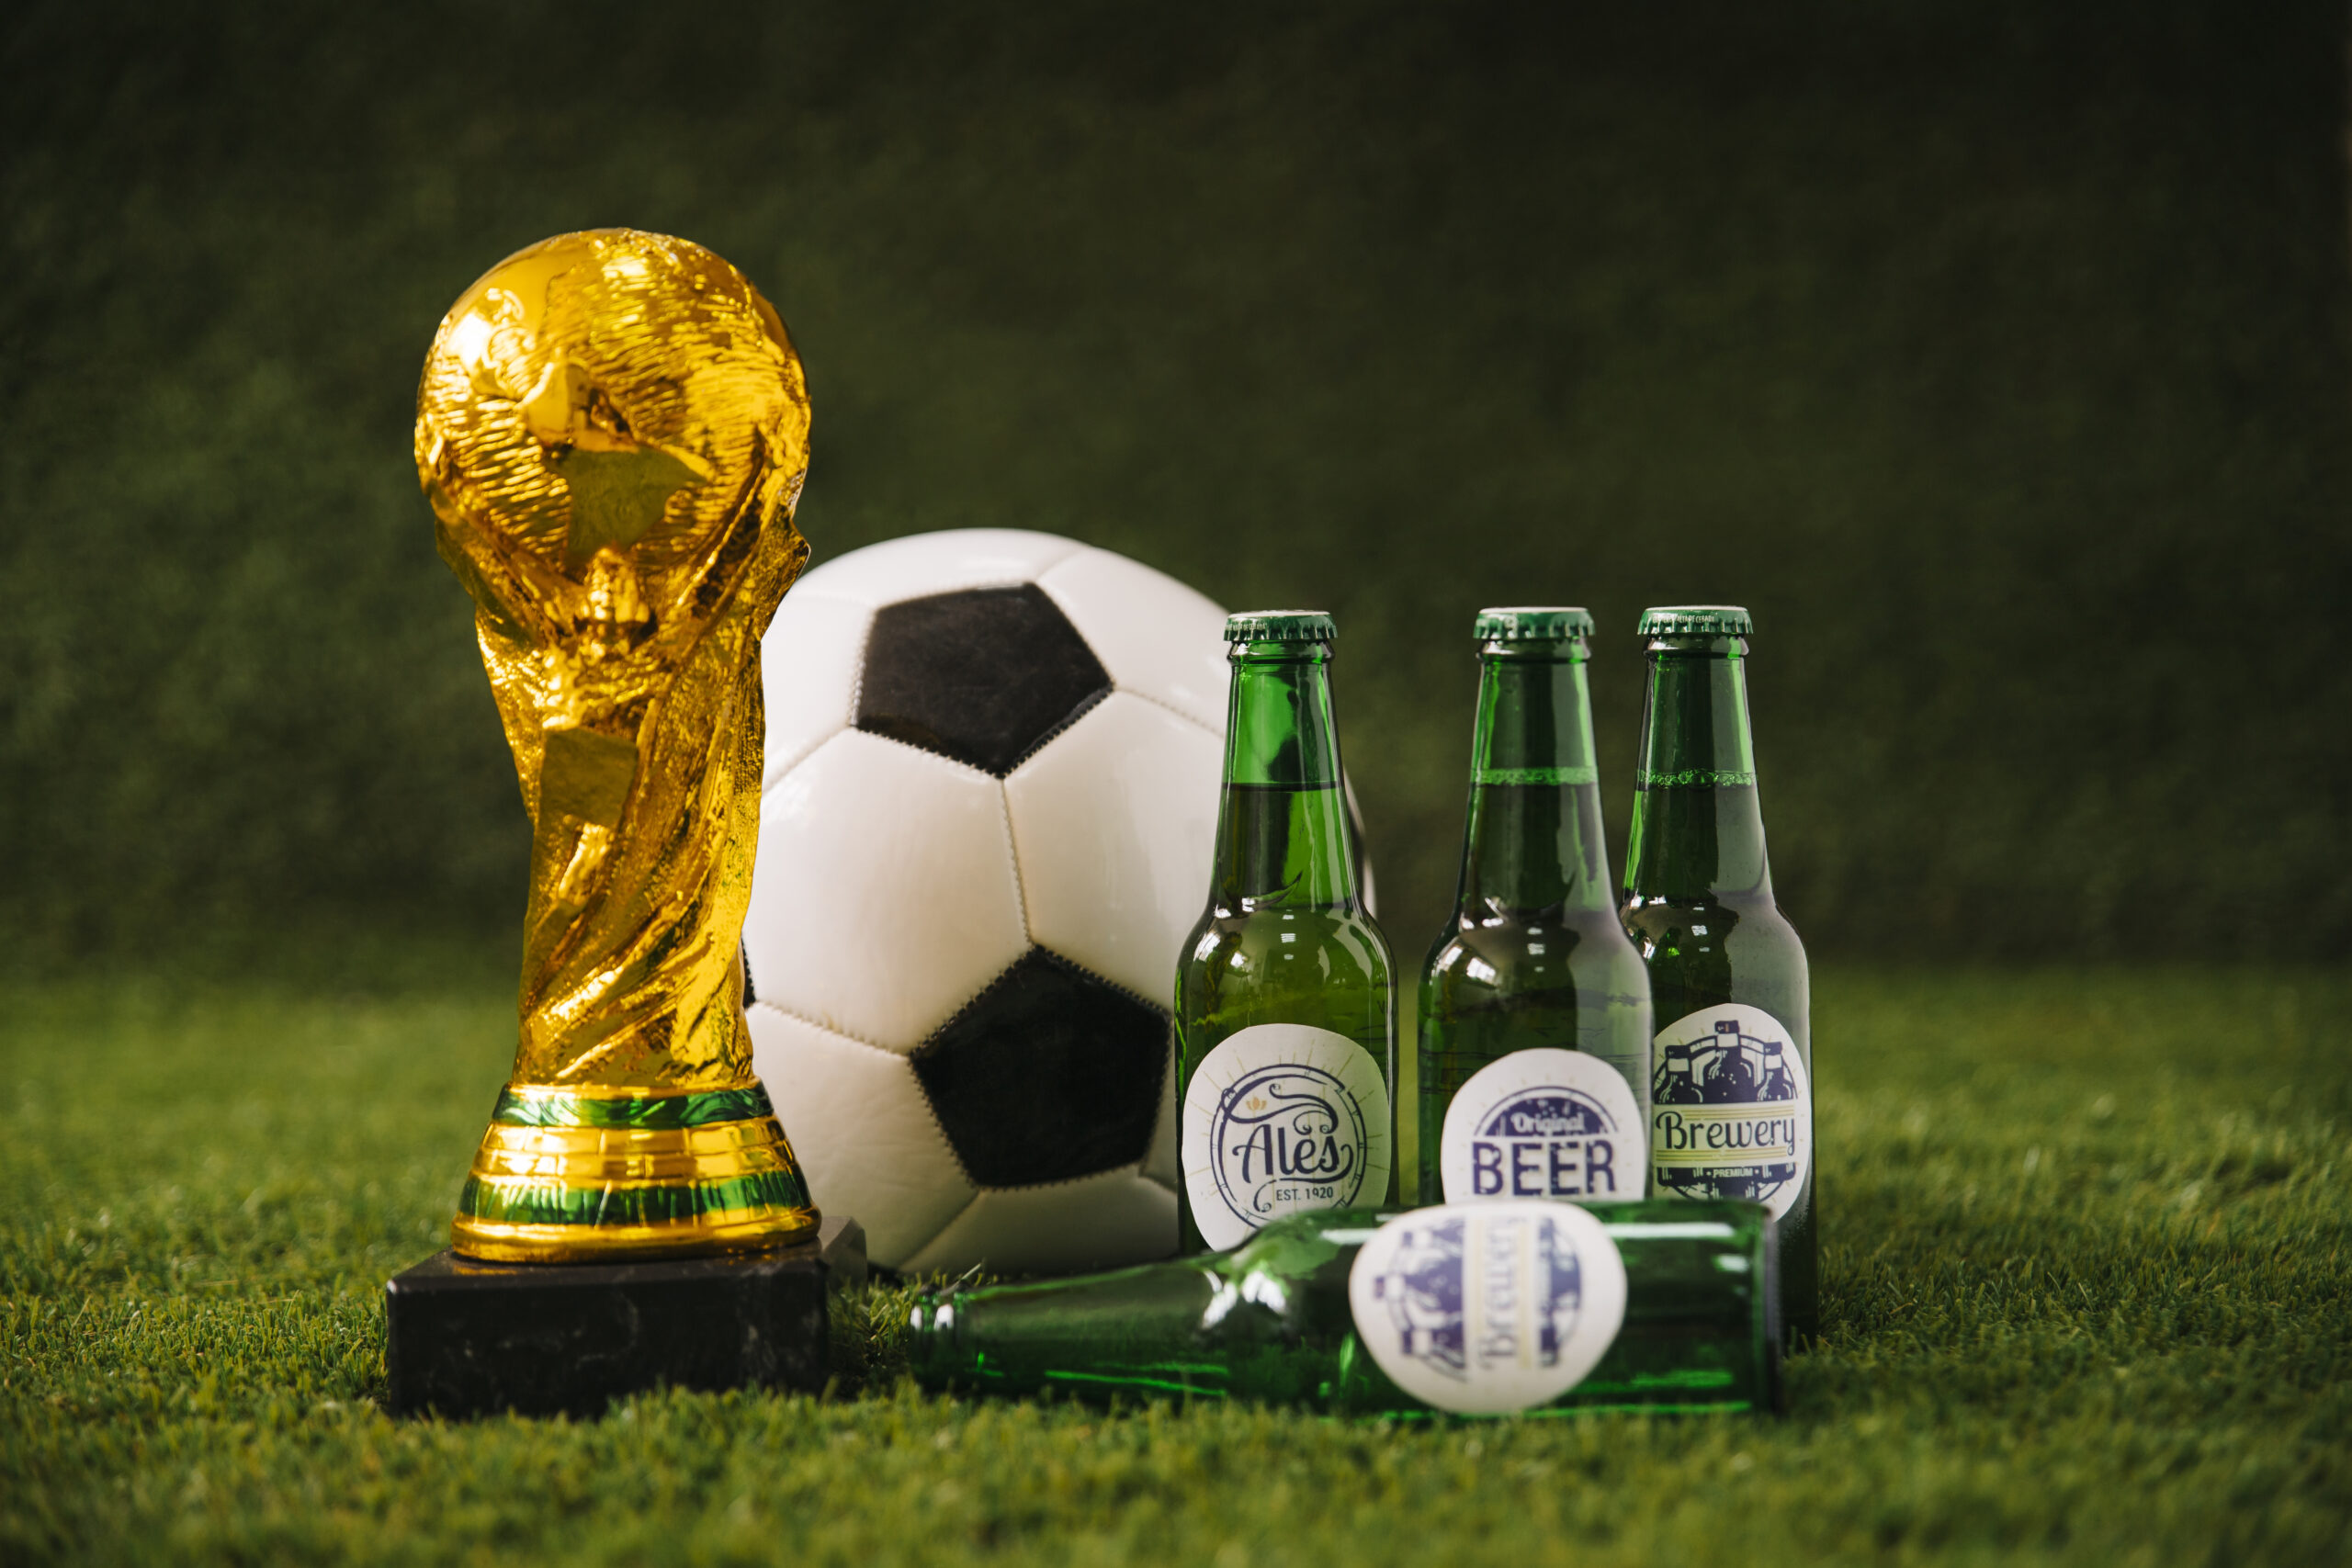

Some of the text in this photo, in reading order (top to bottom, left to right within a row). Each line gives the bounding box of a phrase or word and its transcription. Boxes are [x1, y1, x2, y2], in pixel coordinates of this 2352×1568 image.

[1510, 1112, 1585, 1136] Original
[1656, 1111, 1795, 1156] Brewery
[1232, 1123, 1353, 1184] Ales
[1472, 1141, 1617, 1196] BEER
[1713, 1168, 1754, 1179] PREMIUM
[1276, 1187, 1333, 1201] EST. 1920
